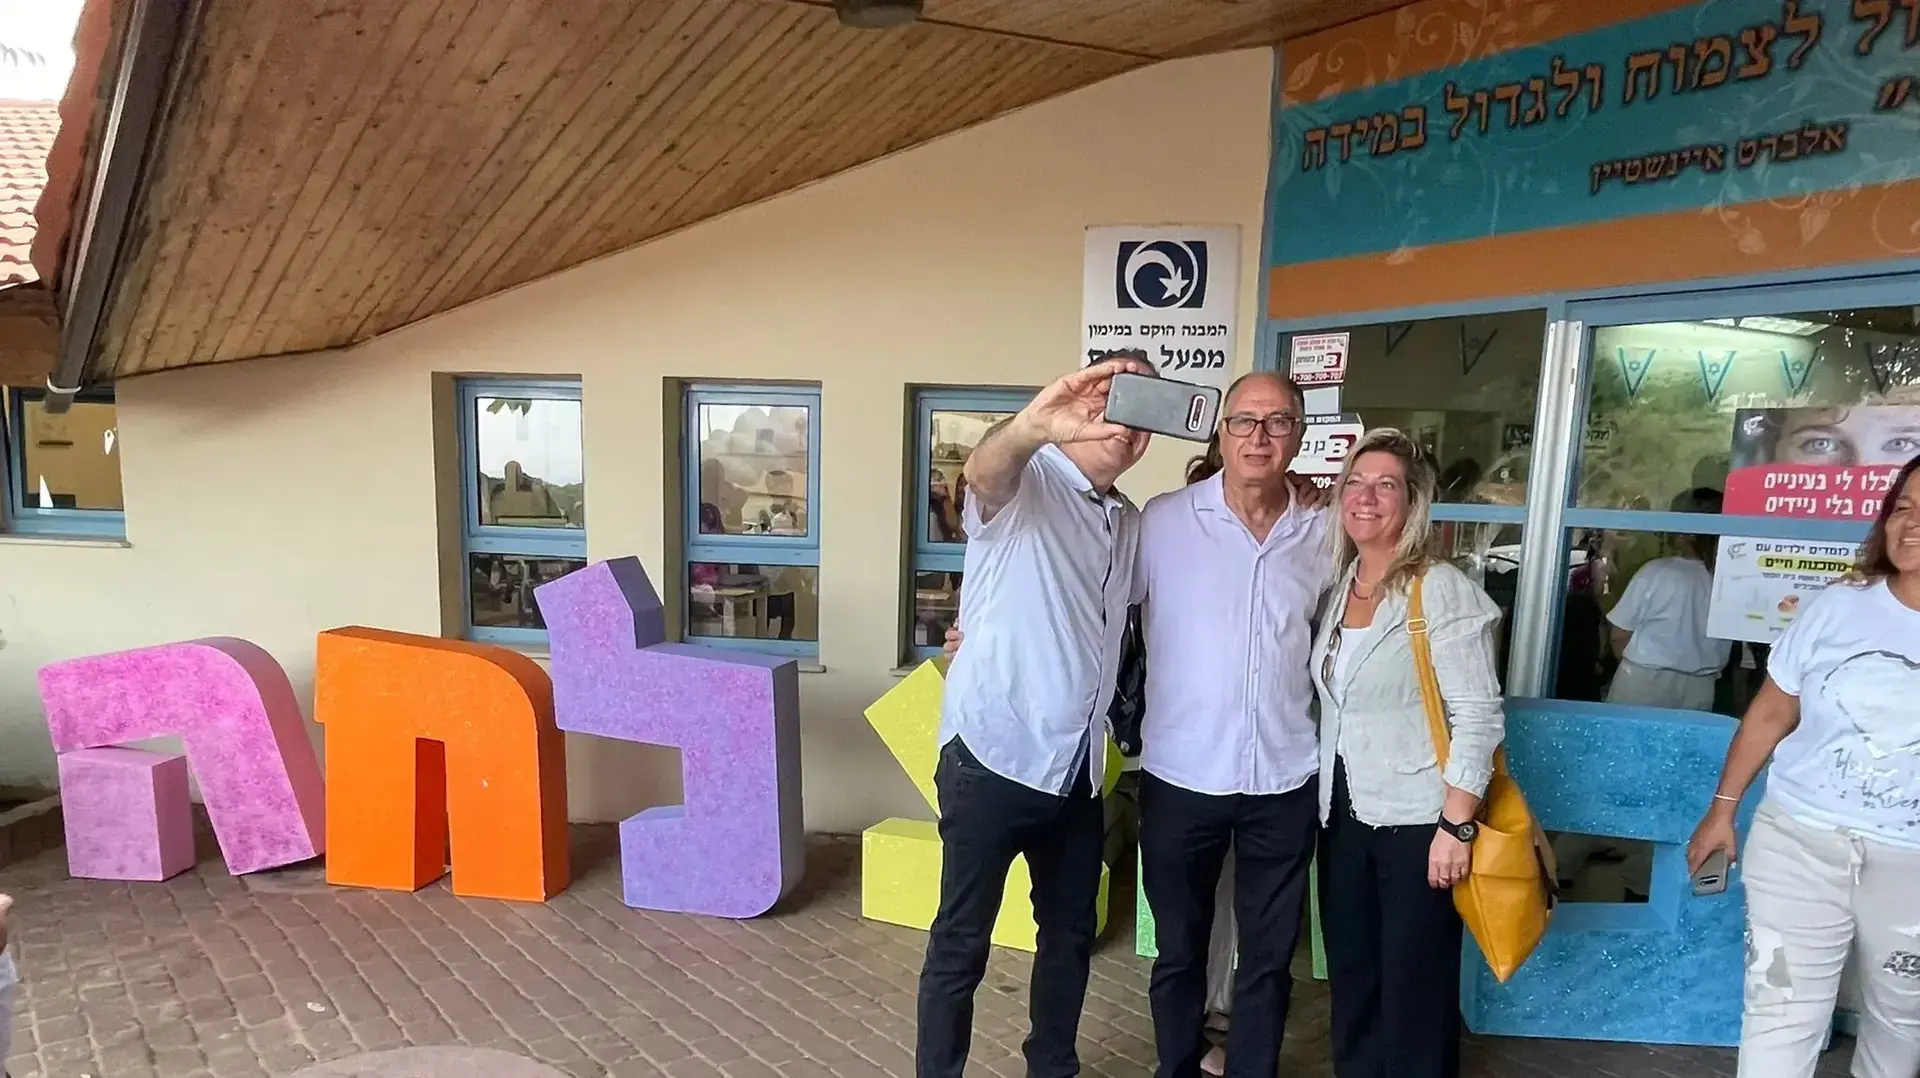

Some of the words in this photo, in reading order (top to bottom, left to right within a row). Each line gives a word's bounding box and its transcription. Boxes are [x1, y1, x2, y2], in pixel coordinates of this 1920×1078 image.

[1622, 0, 1825, 104] לצמוח
[1444, 57, 1604, 140] ולגדול
[1302, 104, 1426, 172] במידה
[1736, 119, 1848, 170] אלברט
[1590, 142, 1726, 195] איינשטיין
[1088, 324, 1132, 338] במימון
[1140, 324, 1175, 338] הוקם
[1182, 324, 1227, 337] המבנה
[1160, 344, 1225, 371] מפעל
[1764, 472, 1827, 491] בעיניים
[1835, 469, 1853, 491] לי
[1765, 496, 1817, 514] ניידים
[1825, 493, 1853, 515] בלי
[1756, 543, 1771, 552] עם
[1775, 543, 1805, 554] ילדים
[1765, 557, 1793, 568] חיים
[1797, 559, 1847, 572] מסכנות
